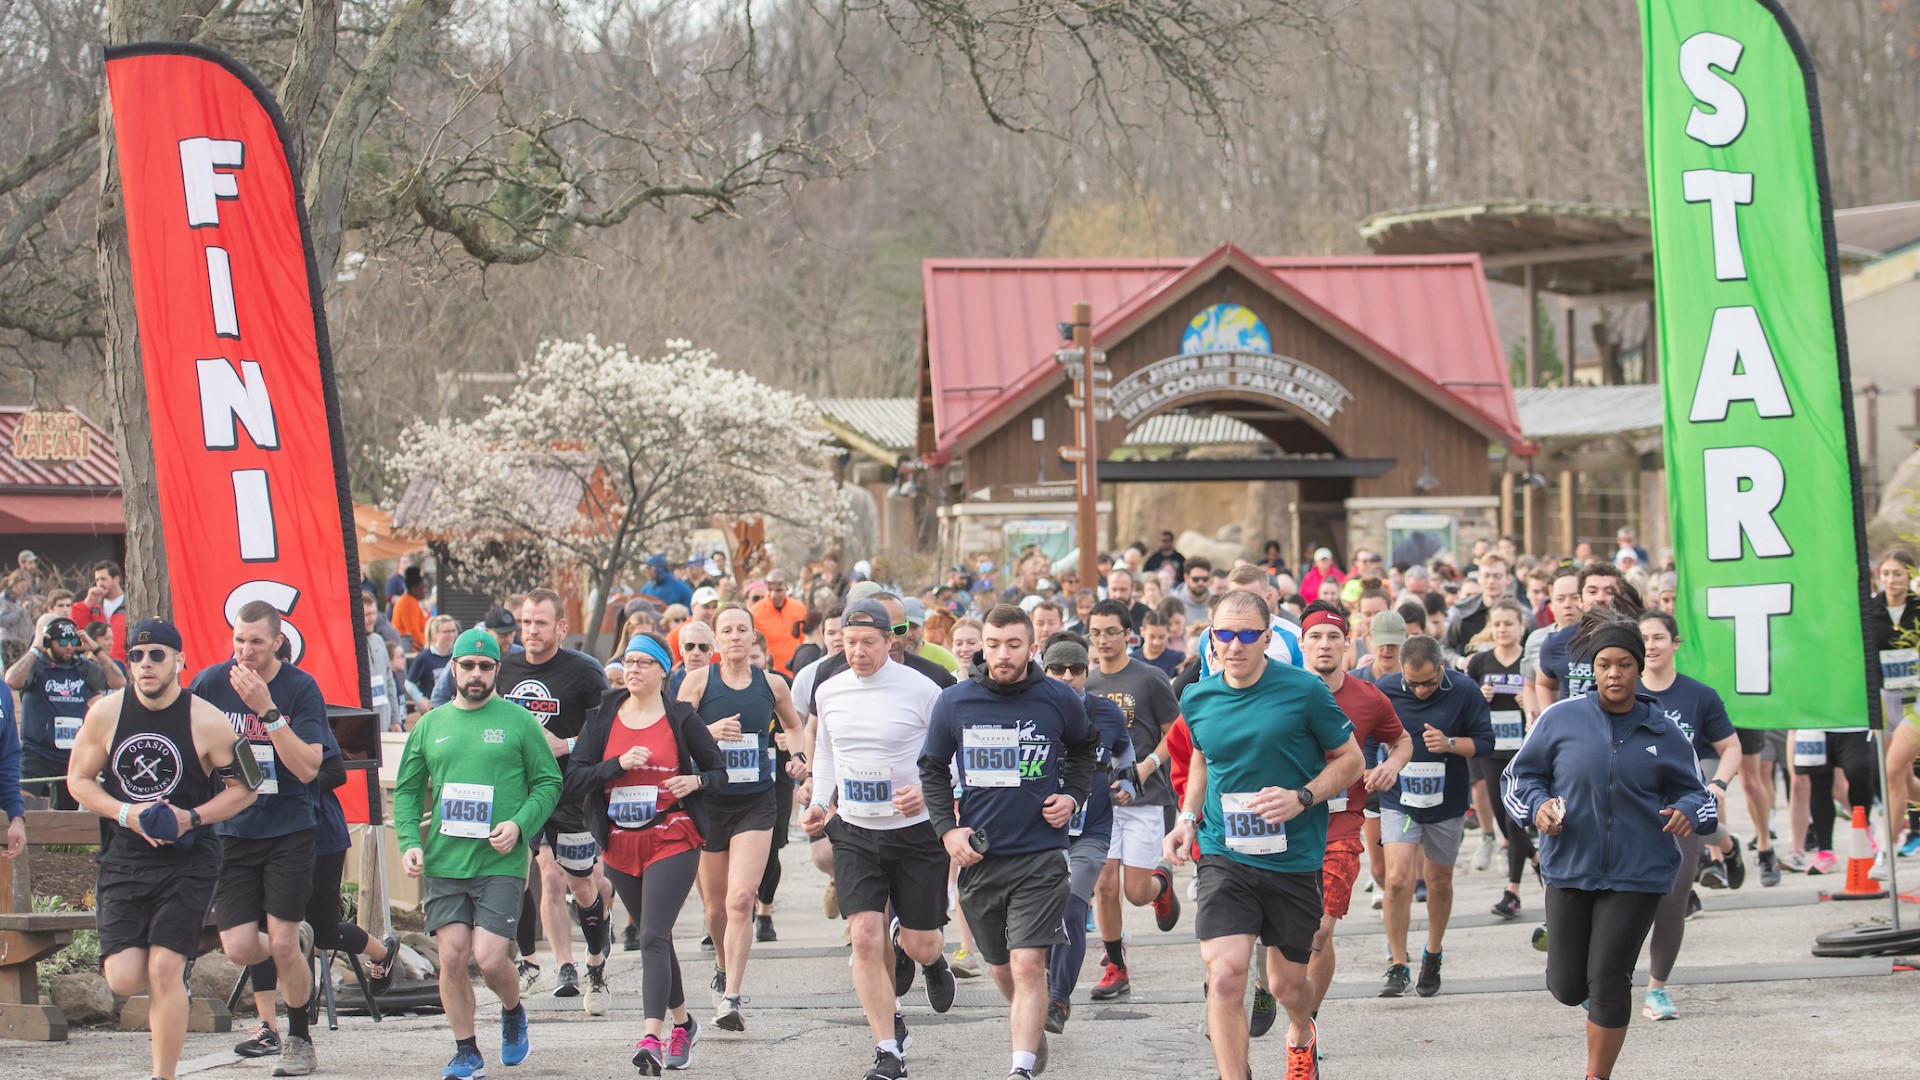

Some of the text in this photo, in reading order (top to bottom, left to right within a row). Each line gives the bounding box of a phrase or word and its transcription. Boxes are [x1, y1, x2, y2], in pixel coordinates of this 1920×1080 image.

[1679, 31, 1794, 696] START
[178, 136, 305, 664] FINIS
[1120, 372, 1336, 420] WELCOME PAVILION
[25, 414, 79, 432] PHOTO
[15, 428, 90, 457] SAFARI
[1013, 486, 1074, 498] THE RAINFOREST
[1494, 723, 1519, 738] 495
[129, 740, 170, 757] OCASIO
[966, 748, 1016, 769] 1650
[846, 781, 888, 802] 1350
[1404, 777, 1441, 795] 1587
[444, 800, 489, 822] 1458
[613, 803, 652, 821] 1457
[561, 842, 596, 860] 1633
